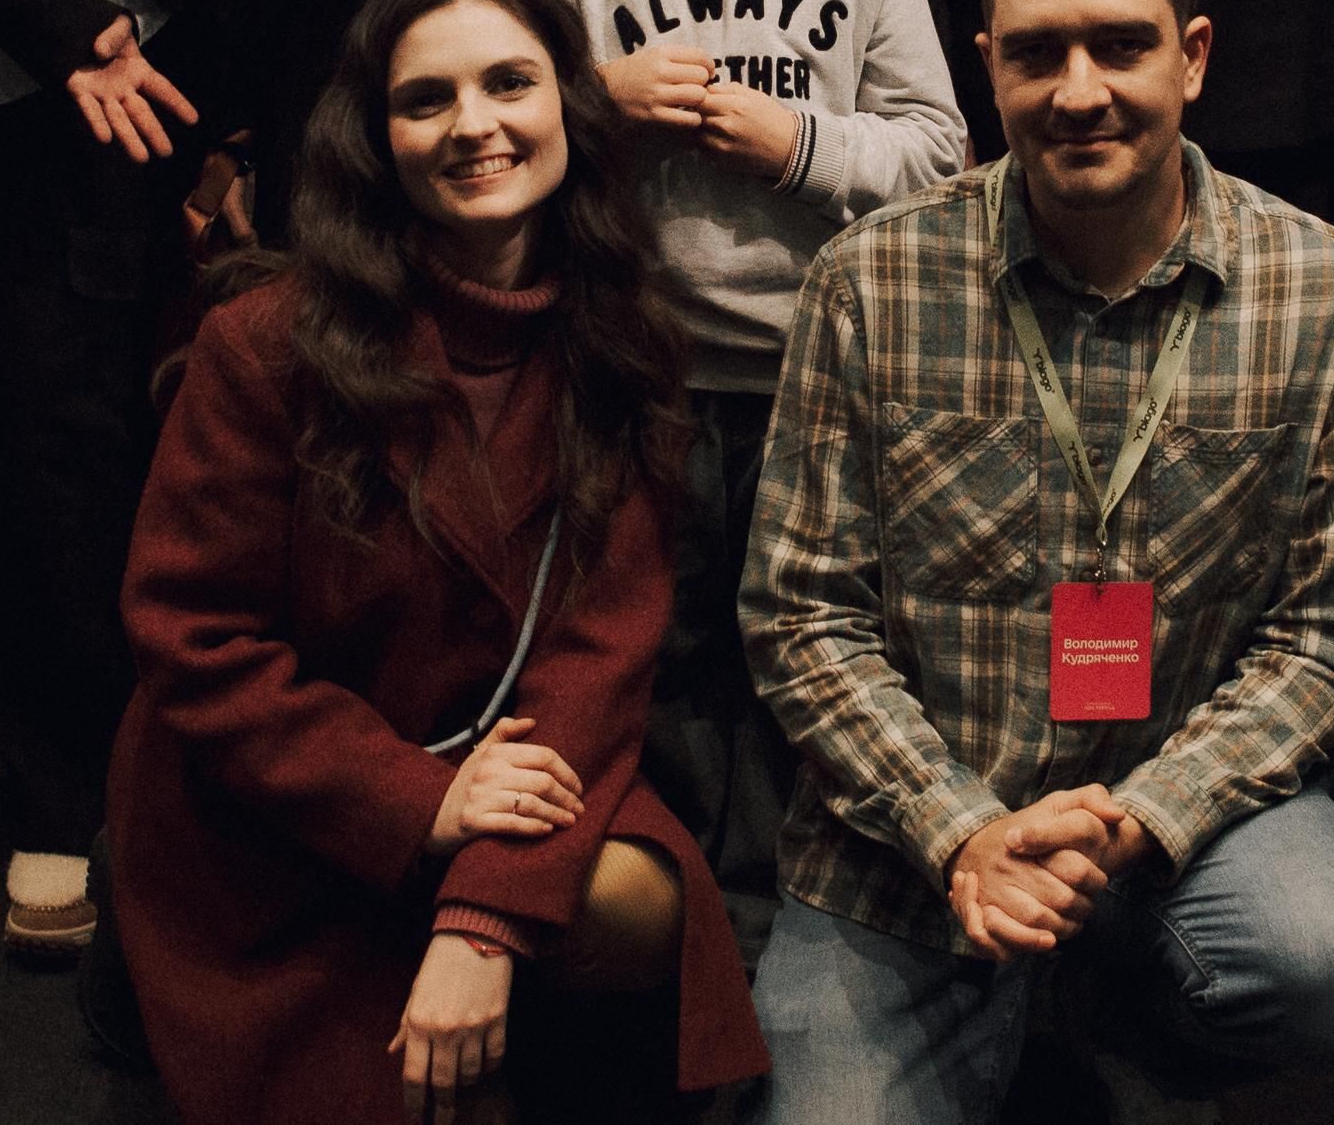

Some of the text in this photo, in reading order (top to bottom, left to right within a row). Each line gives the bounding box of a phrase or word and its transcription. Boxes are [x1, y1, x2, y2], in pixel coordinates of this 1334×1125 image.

[707, 56, 811, 100] THER
[1064, 638, 1139, 650] Володимир
[1062, 653, 1139, 666] Кудряченко
